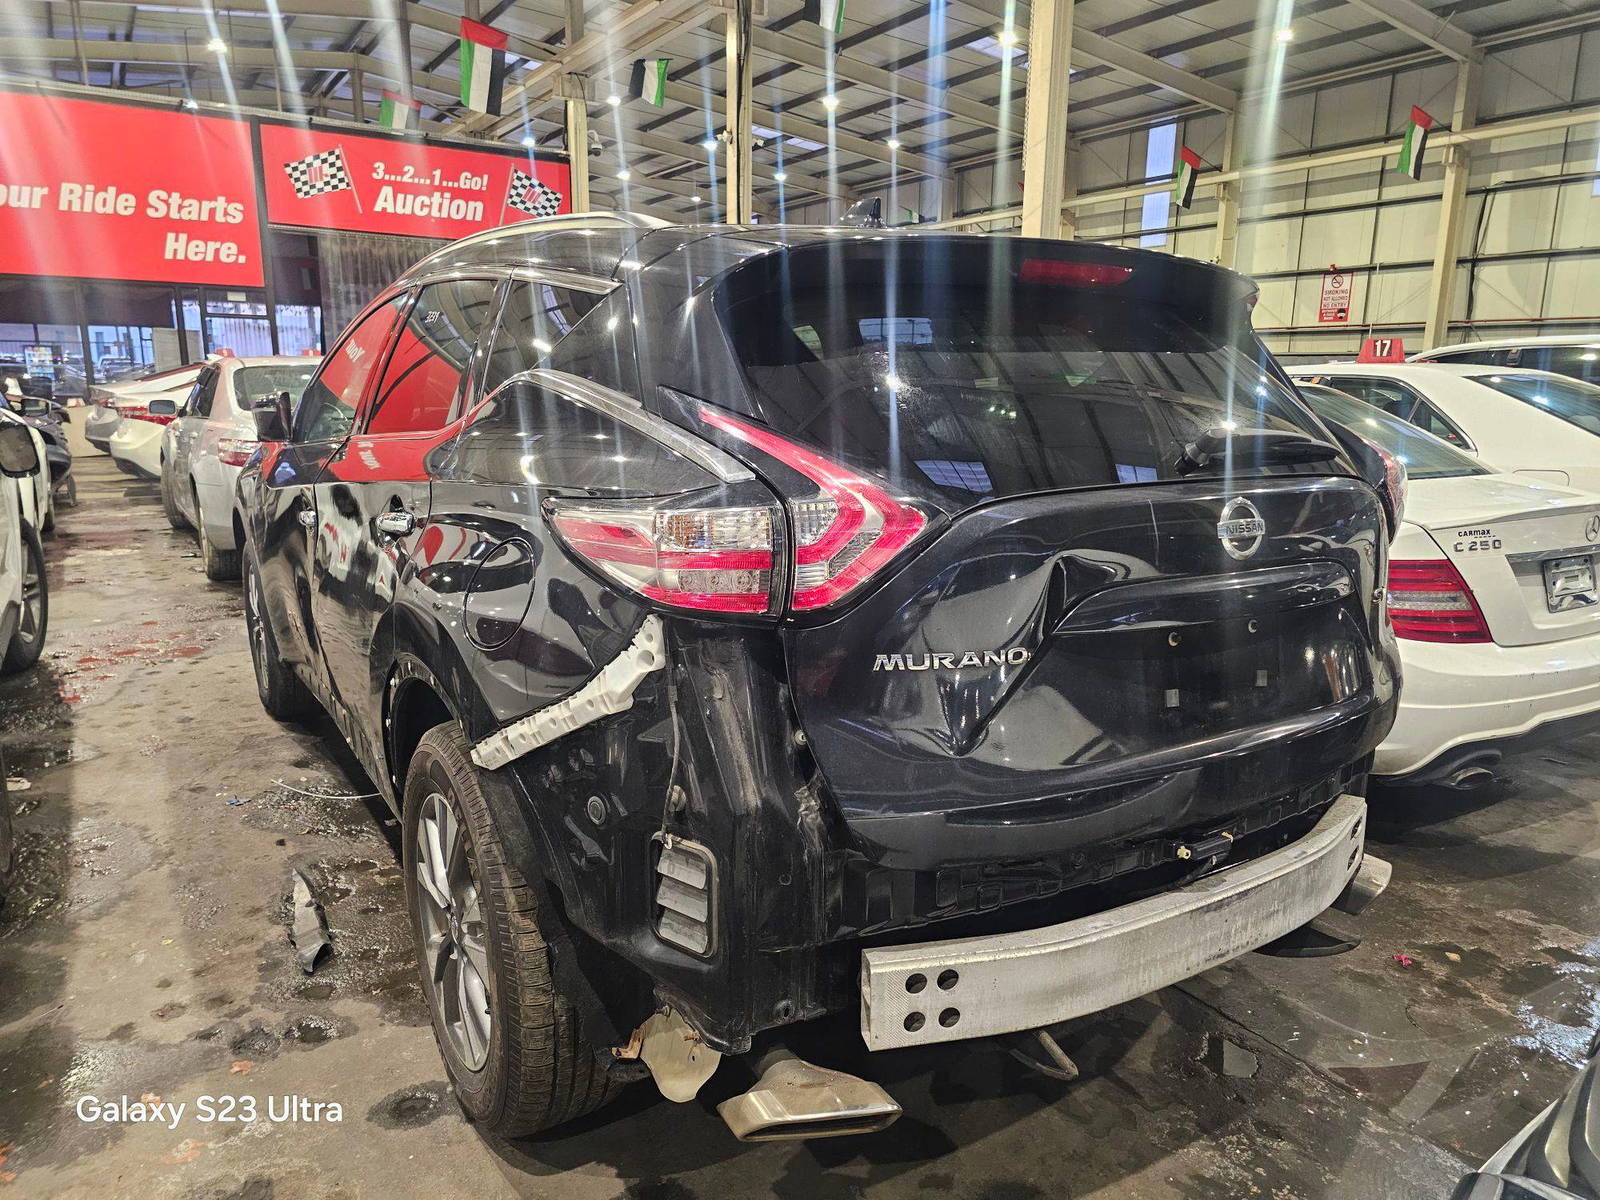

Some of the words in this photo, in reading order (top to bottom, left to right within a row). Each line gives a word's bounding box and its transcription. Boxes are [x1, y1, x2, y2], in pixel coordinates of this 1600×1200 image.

[58, 181, 137, 216] Ride
[146, 189, 244, 224] Starts
[373, 185, 484, 221] Auction
[164, 231, 247, 263] Here.
[1375, 340, 1391, 357] 17
[1227, 521, 1264, 535] NISSAN
[1453, 542, 1464, 552] C
[1468, 539, 1502, 551] 250
[872, 647, 1030, 671] MURANO
